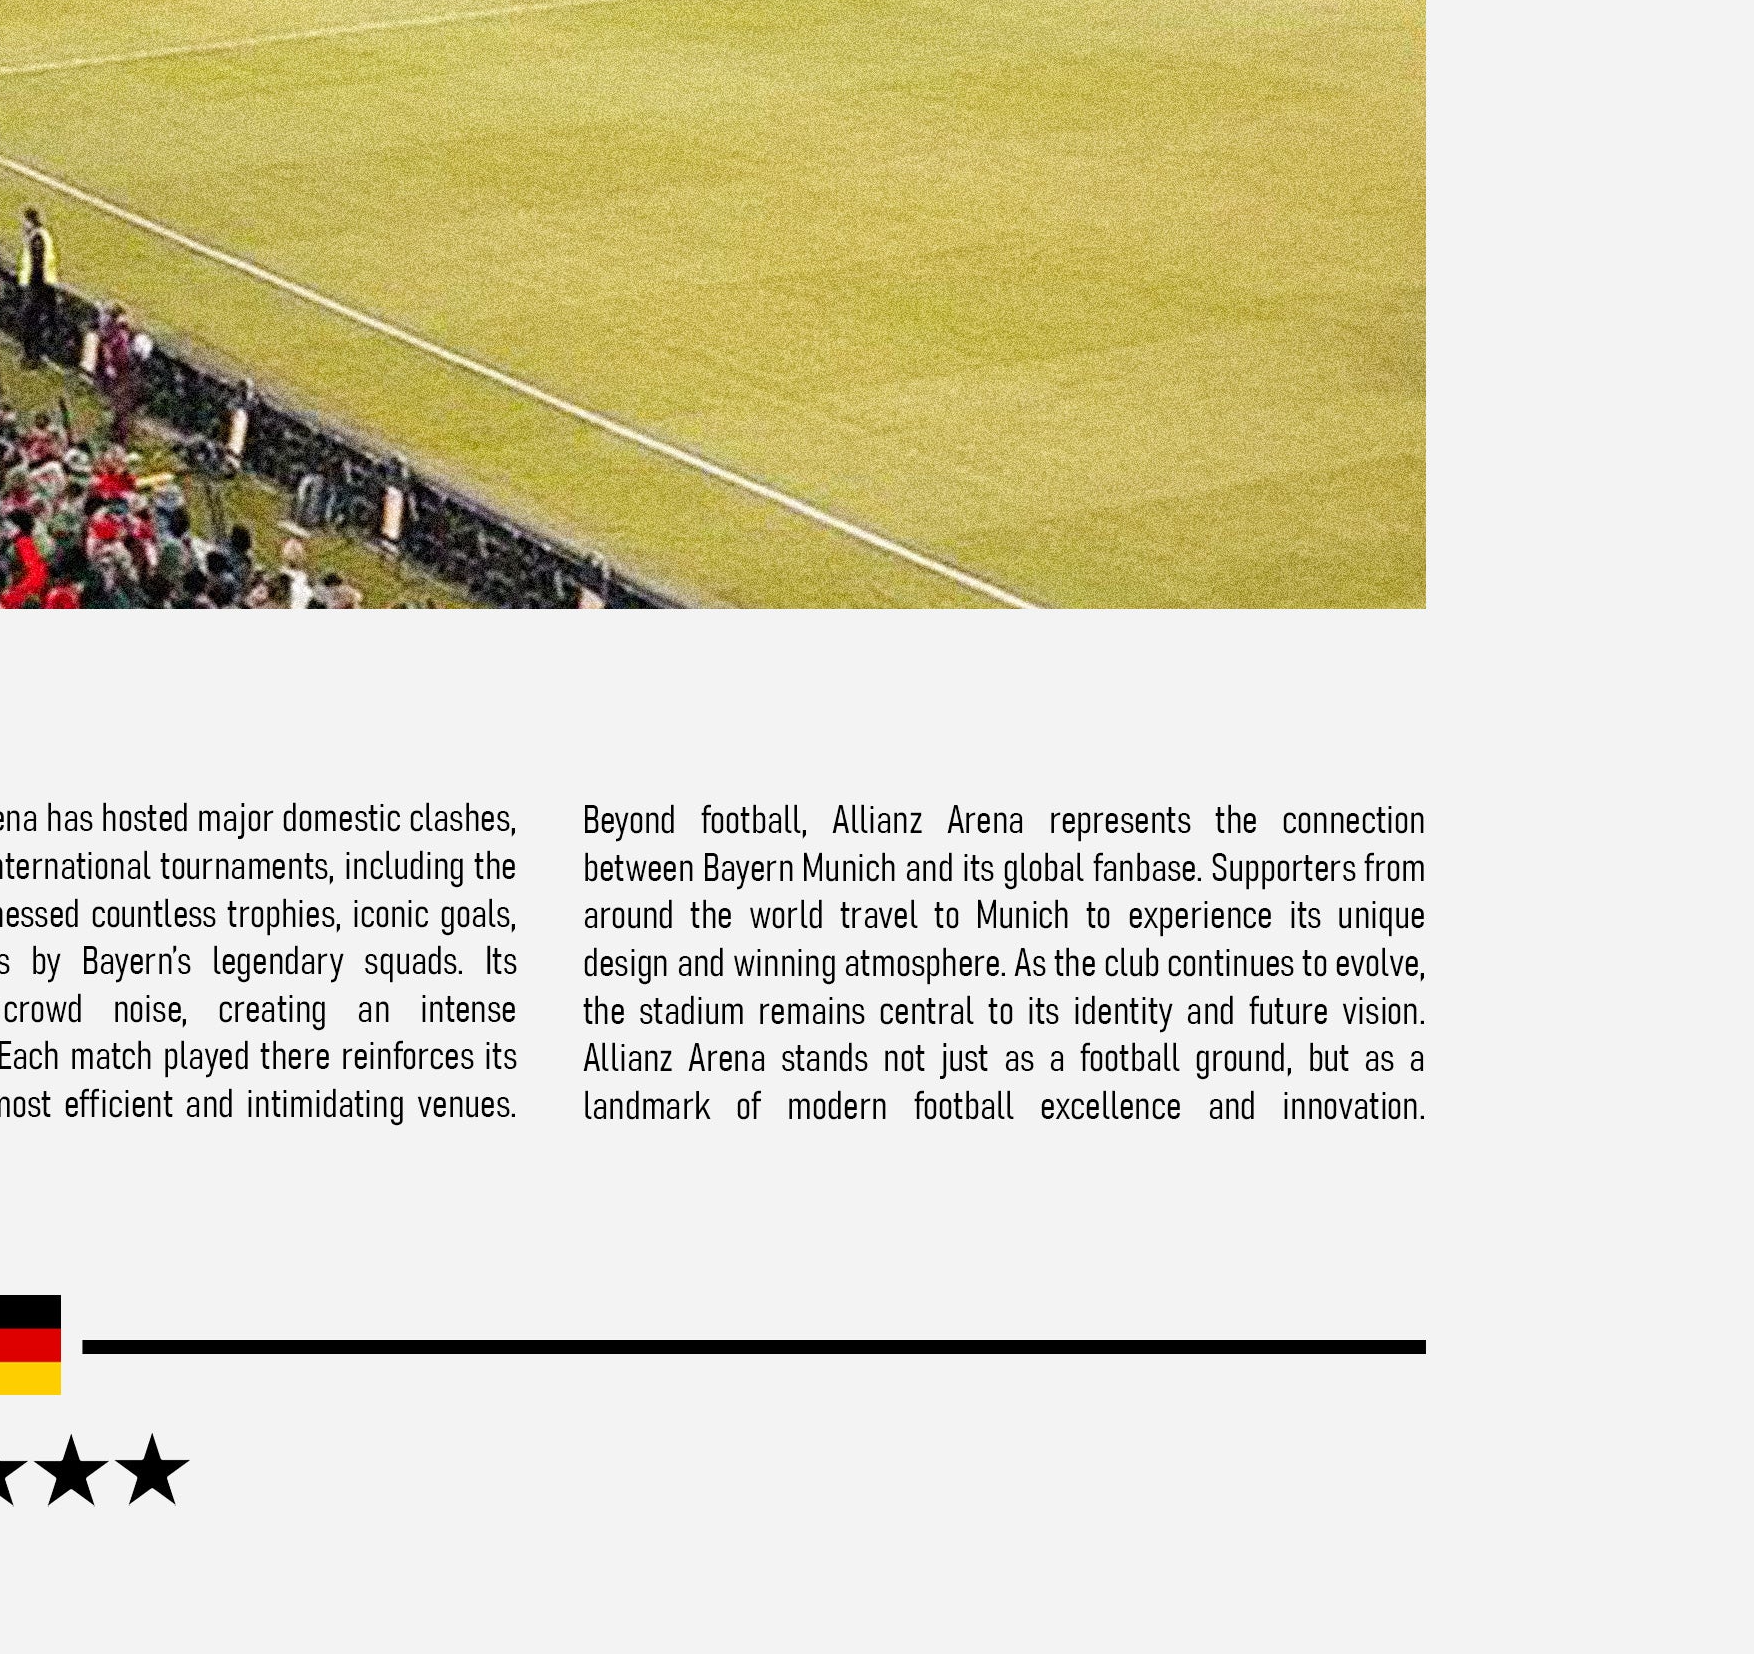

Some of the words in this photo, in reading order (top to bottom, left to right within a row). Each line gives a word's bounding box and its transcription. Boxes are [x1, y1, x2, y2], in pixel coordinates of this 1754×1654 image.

[47, 802, 93, 832] has
[102, 802, 188, 832] hosted
[198, 802, 274, 840] major
[283, 802, 401, 832] domestic
[410, 802, 516, 837] clashes,
[584, 804, 675, 842] Beyond
[701, 804, 807, 839] football,
[832, 804, 923, 834] Allianz
[947, 804, 1023, 834] Arena
[1050, 806, 1191, 842] represents
[1215, 804, 1257, 834] the
[1283, 805, 1424, 834] connection
[160, 852, 334, 885] tournaments,
[346, 850, 464, 888] including
[474, 850, 516, 880] the
[584, 852, 693, 882] between
[704, 852, 793, 890] Bayern
[803, 852, 895, 882] Munich
[906, 852, 953, 882] and
[963, 853, 994, 882] its
[1004, 852, 1085, 890] global
[1093, 852, 1202, 882] fanbase.
[1212, 852, 1356, 890] Supporters
[1364, 852, 1425, 882] from
[32, 945, 61, 983] by
[213, 945, 344, 983] legendary
[364, 945, 463, 983] squads.
[486, 945, 517, 975] Its
[584, 947, 667, 985] design
[678, 947, 724, 977] and
[733, 948, 836, 985] winning
[845, 947, 1006, 985] atmosphere.
[1014, 947, 1046, 977] As
[1054, 947, 1096, 977] the
[1105, 947, 1159, 977] club
[1168, 948, 1294, 977] continues
[1302, 949, 1327, 977] to
[1336, 947, 1425, 982] evolve,
[4, 993, 82, 1023] crowd
[114, 994, 187, 1028] noise,
[219, 994, 326, 1031] creating
[358, 1000, 389, 1023] an
[422, 994, 516, 1023] intense
[583, 995, 625, 1025] the
[639, 995, 744, 1025] stadium
[759, 996, 865, 1025] remains
[880, 995, 974, 1025] central
[988, 997, 1013, 1025] to
[1029, 996, 1059, 1025] its
[1074, 995, 1173, 1033] identity
[1187, 995, 1234, 1025] and
[1249, 995, 1328, 1025] future
[1342, 996, 1425, 1025] vision.
[65, 1088, 173, 1118] efficient
[186, 1088, 233, 1118] and
[248, 1088, 404, 1126] intimidating
[417, 1096, 516, 1118] venues.
[584, 1090, 711, 1120] landmark
[737, 1090, 762, 1120] of
[788, 1090, 886, 1120] modern
[914, 1090, 1014, 1120] football
[1041, 1090, 1181, 1120] excellence
[1209, 1090, 1255, 1120] and
[1283, 1091, 1425, 1120] innovation.
